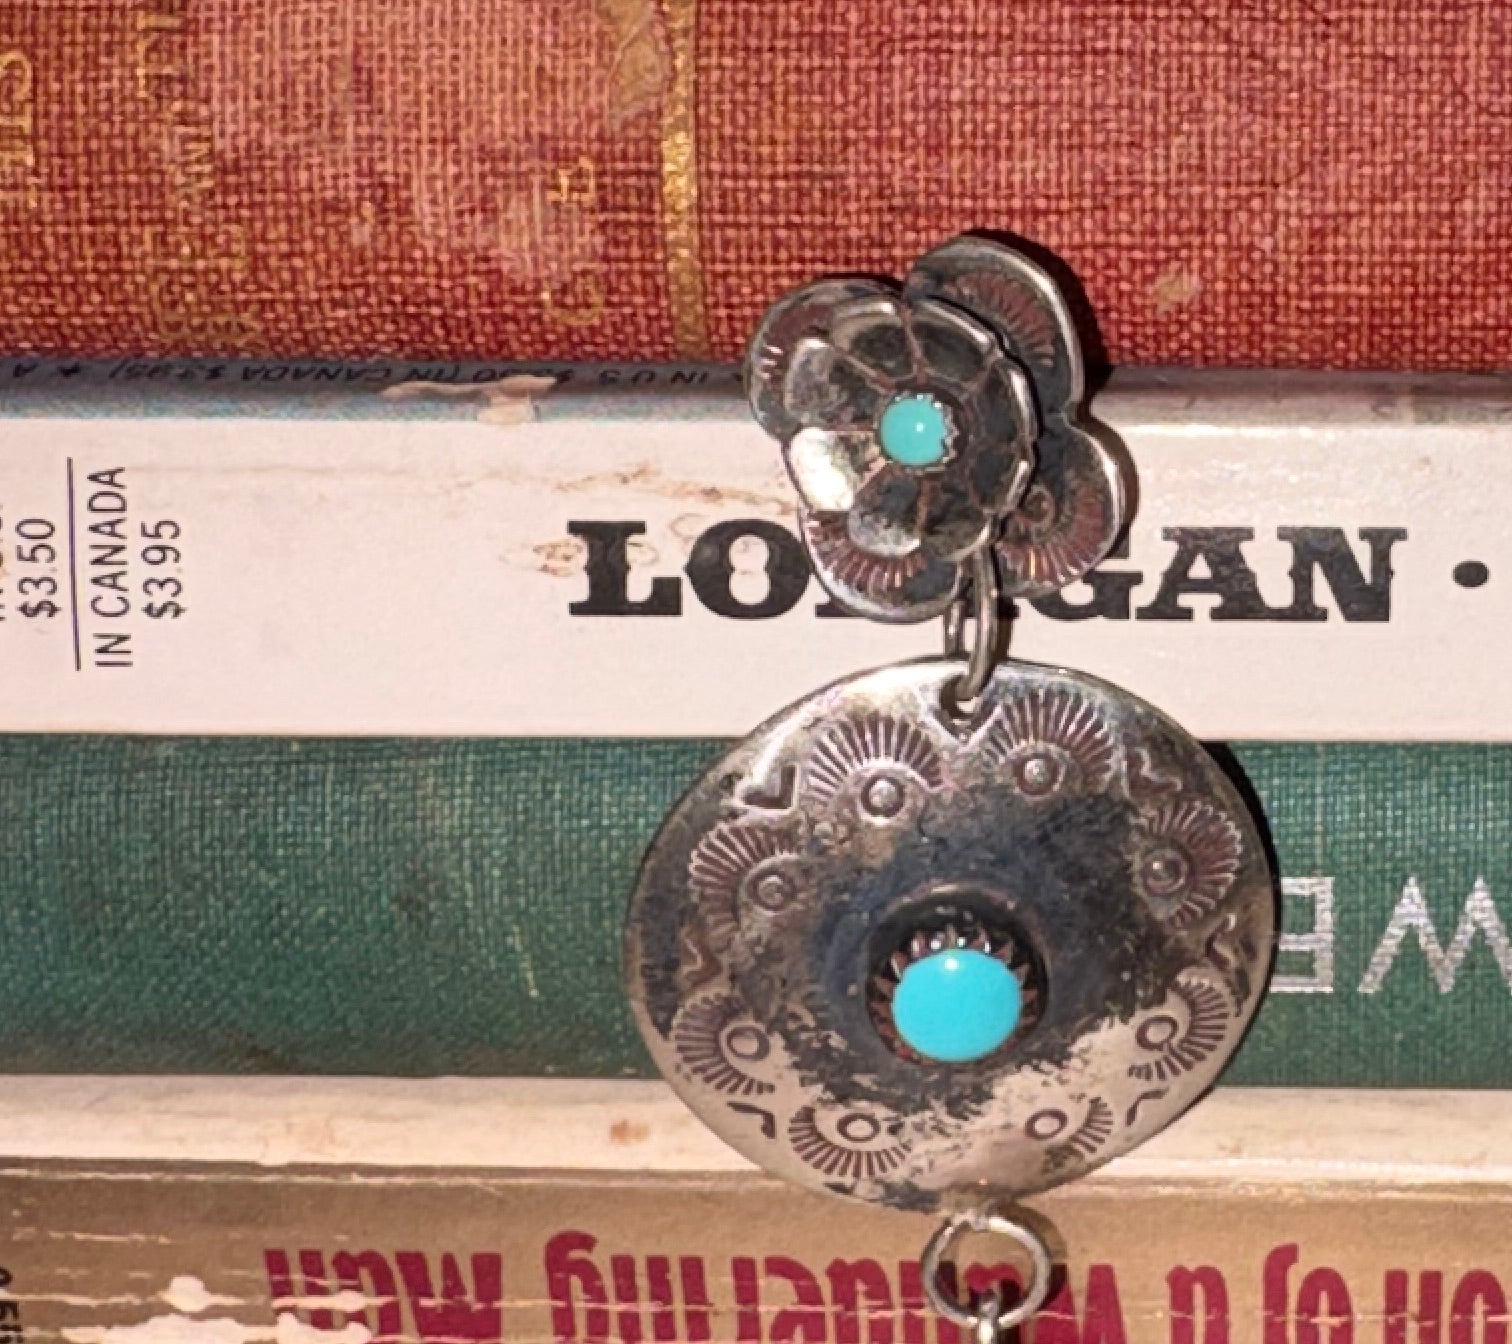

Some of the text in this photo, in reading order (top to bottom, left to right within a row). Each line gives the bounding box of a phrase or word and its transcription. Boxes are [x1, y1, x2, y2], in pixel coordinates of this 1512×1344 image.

[15, 517, 60, 617] $3.50
[87, 466, 133, 667] IN CANADA
[141, 519, 186, 618] $3.95
